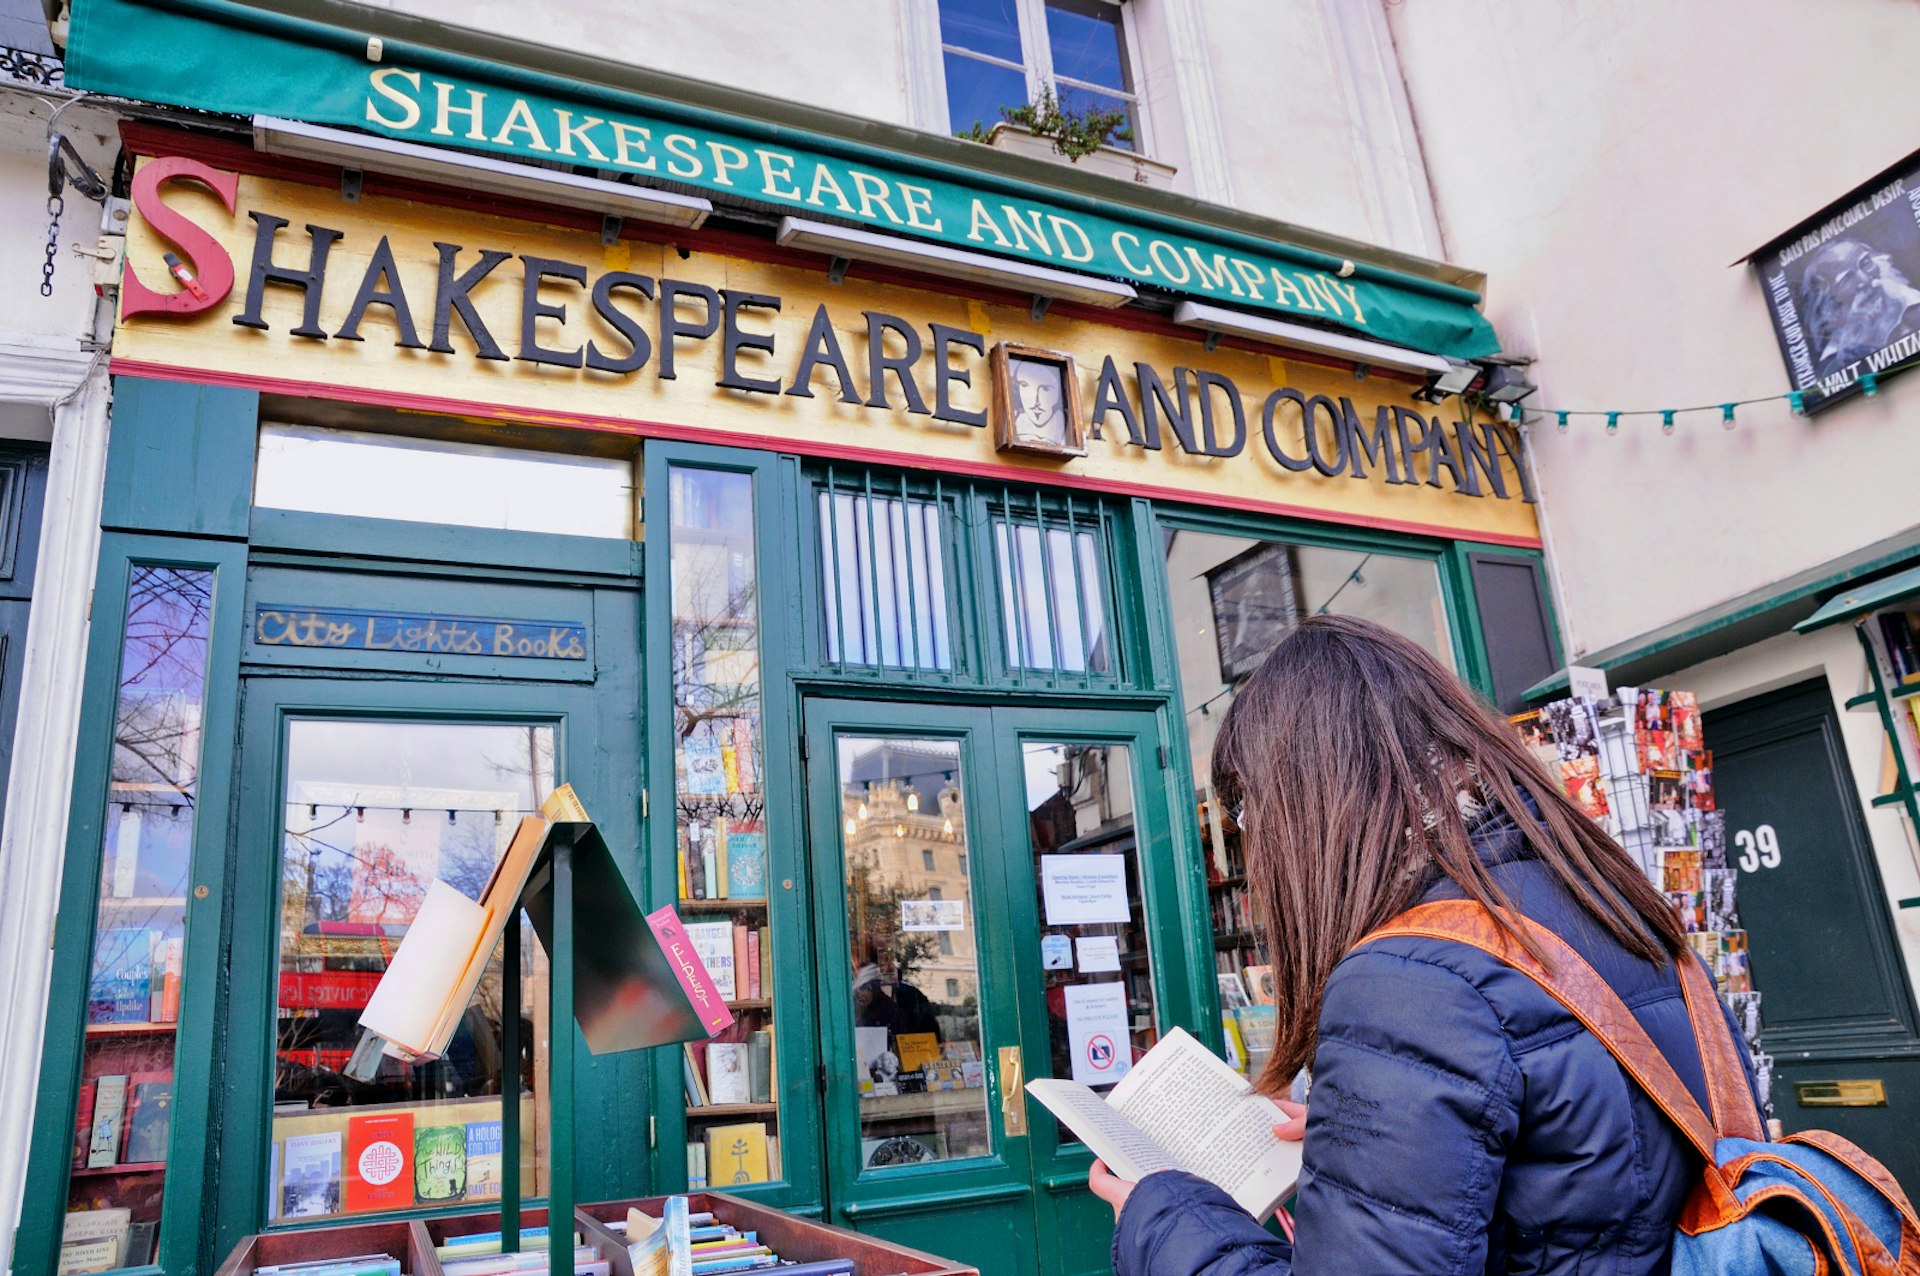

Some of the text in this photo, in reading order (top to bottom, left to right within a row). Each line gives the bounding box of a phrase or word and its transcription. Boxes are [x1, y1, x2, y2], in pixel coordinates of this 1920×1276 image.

[365, 67, 1368, 325] SHAKESPEARE AND COMPANY
[121, 155, 1538, 506] SHAKESPEARE AND COMPANY
[1816, 361, 1861, 398] WALT
[257, 611, 357, 645] City
[364, 617, 483, 655] Lights
[1735, 824, 1781, 874] 39
[116, 964, 148, 986] Couples
[670, 942, 710, 1009] ELDEST
[115, 1000, 143, 1016] Updike
[468, 1127, 476, 1142] A
[468, 1183, 487, 1196] DAVE
